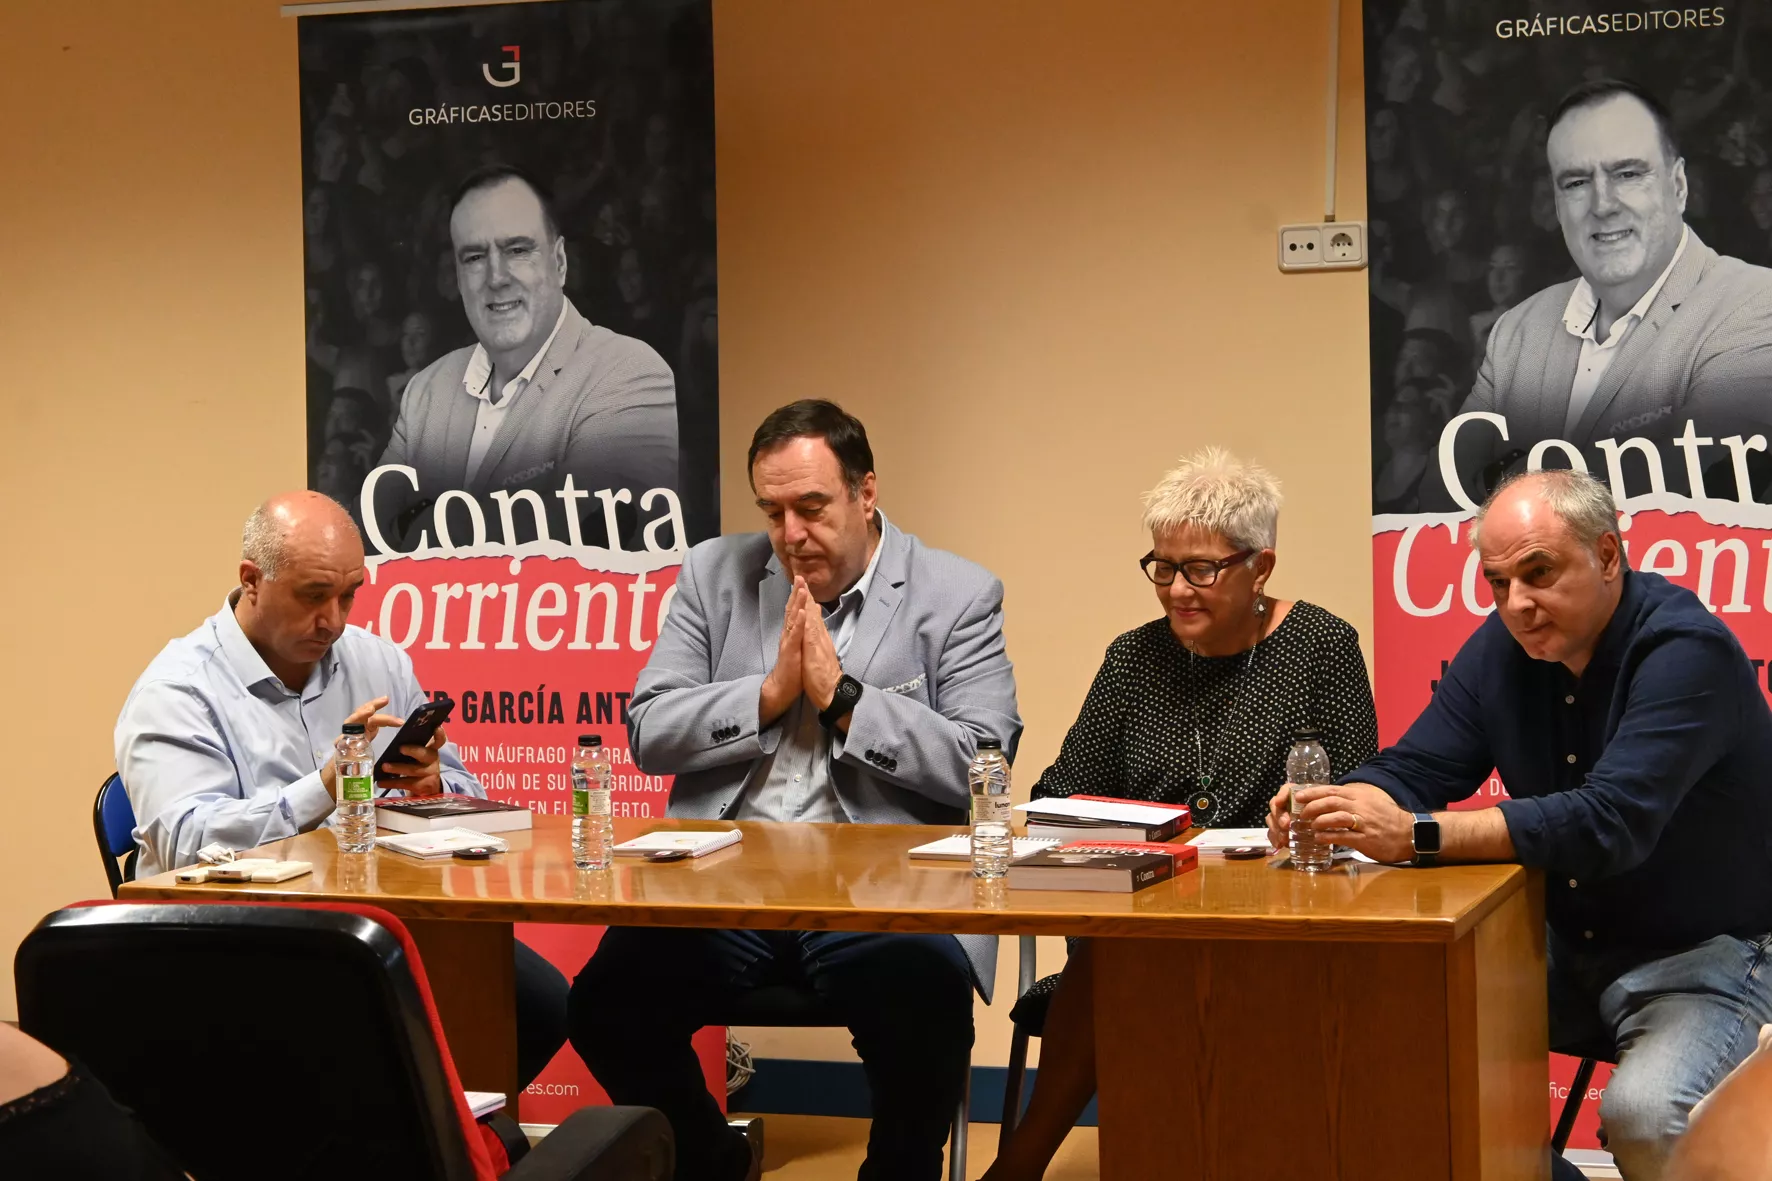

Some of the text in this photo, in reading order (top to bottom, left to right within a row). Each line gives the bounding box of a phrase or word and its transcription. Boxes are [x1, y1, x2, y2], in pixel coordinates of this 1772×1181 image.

[1495, 7, 1726, 39] GRÁFICASEDITORES
[408, 99, 597, 125] GRÁFICASEDITORES
[360, 463, 693, 555] Contra
[461, 683, 565, 724] GARCÍA
[576, 691, 631, 725] ANT
[459, 745, 480, 763] UN
[485, 742, 567, 764] NÁUFRAGO
[522, 773, 541, 791] DE
[547, 773, 567, 791] SU
[610, 774, 668, 793] GRIDAD.
[612, 802, 655, 819] ERTO.
[525, 1082, 579, 1096] es.com
